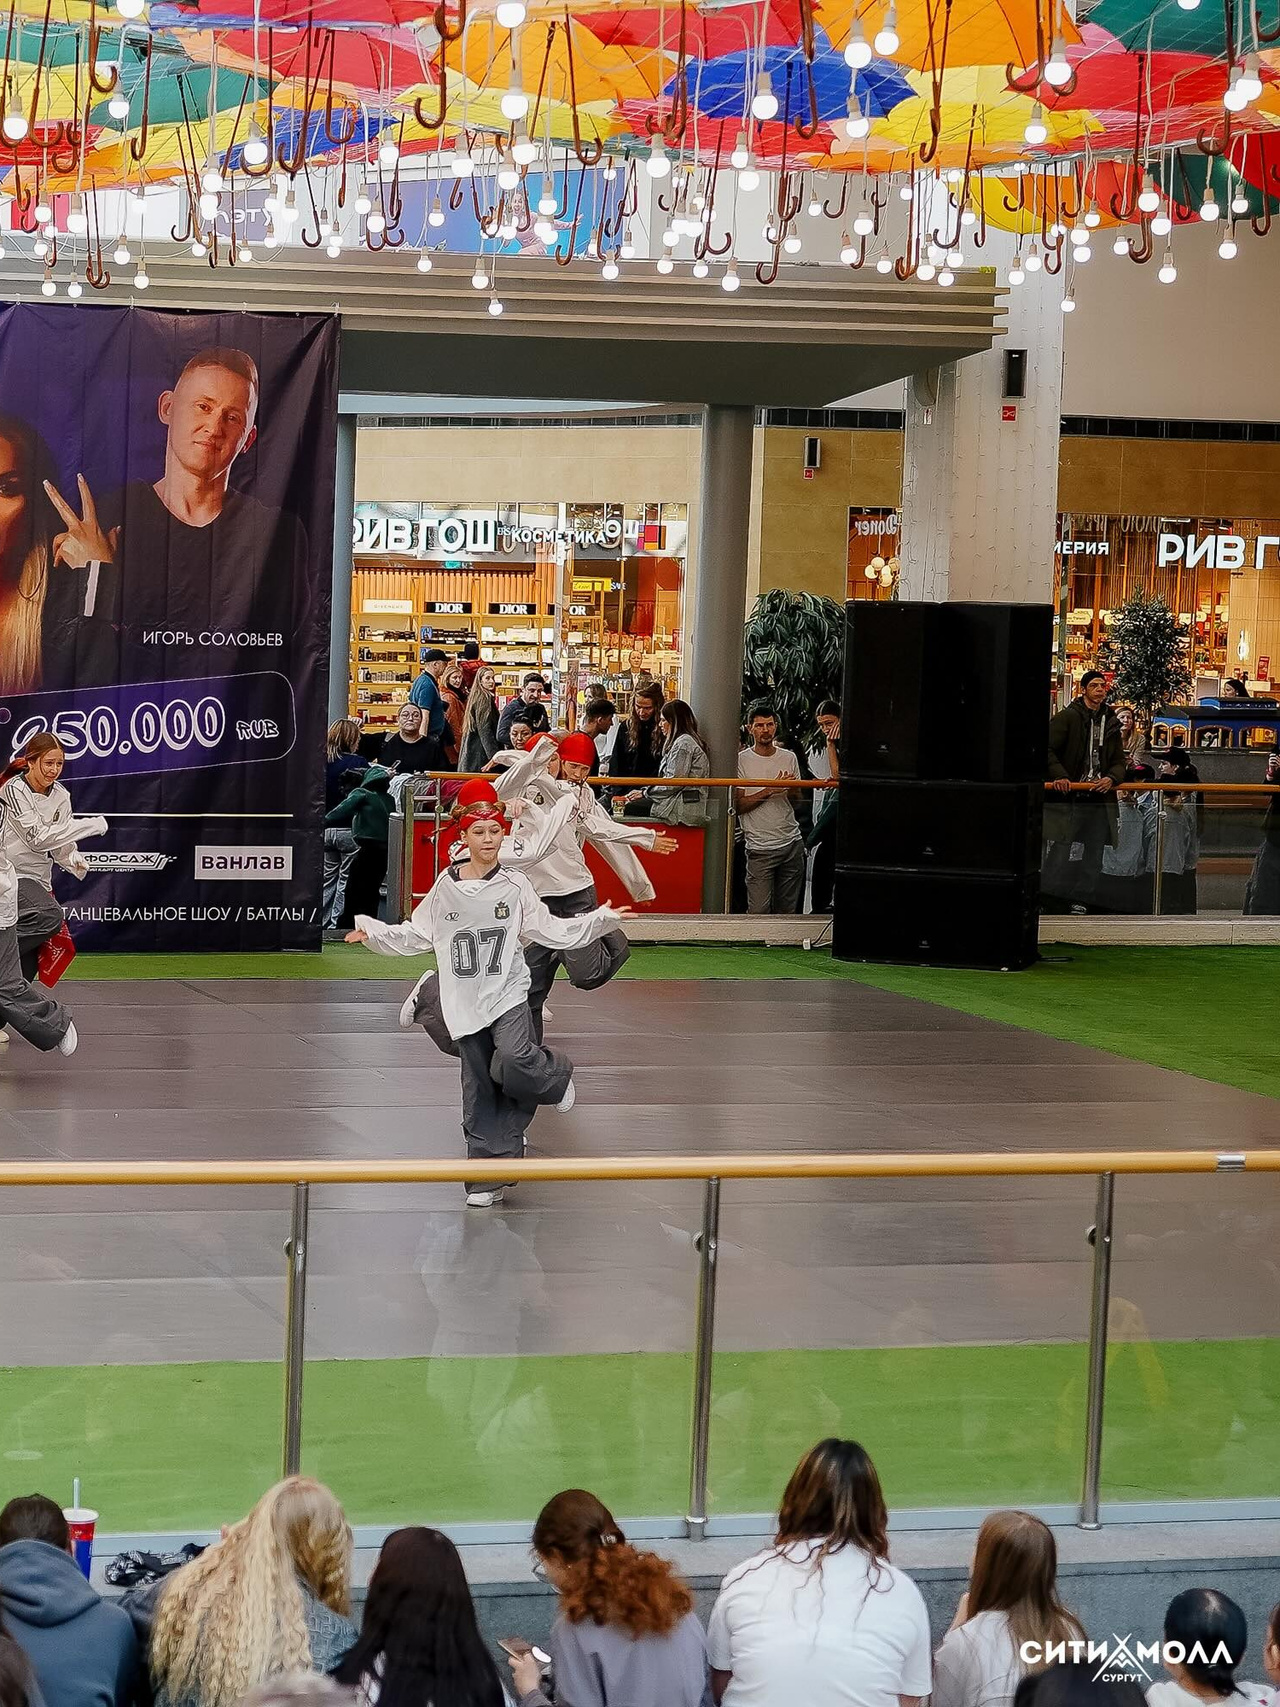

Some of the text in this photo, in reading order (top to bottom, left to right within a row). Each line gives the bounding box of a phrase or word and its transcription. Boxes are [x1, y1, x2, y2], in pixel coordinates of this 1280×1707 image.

[419, 518, 496, 552] ГОШ
[512, 529, 607, 544] КОСМЕТИКА
[1158, 533, 1245, 570] РИВ
[435, 602, 464, 613] DIOR
[499, 604, 528, 614] DIOR
[143, 631, 283, 646] ИГОРЬ СОЛОВЬЕВ
[236, 719, 280, 740] RUB
[84, 854, 155, 864] ФОРСАЖ
[201, 854, 286, 870] ванлав
[61, 907, 187, 922] ТАНЦЕВАЛЬНОЕ
[191, 907, 231, 921] ШОУ
[246, 907, 305, 922] БАТТЛЫ
[451, 926, 507, 978] 07
